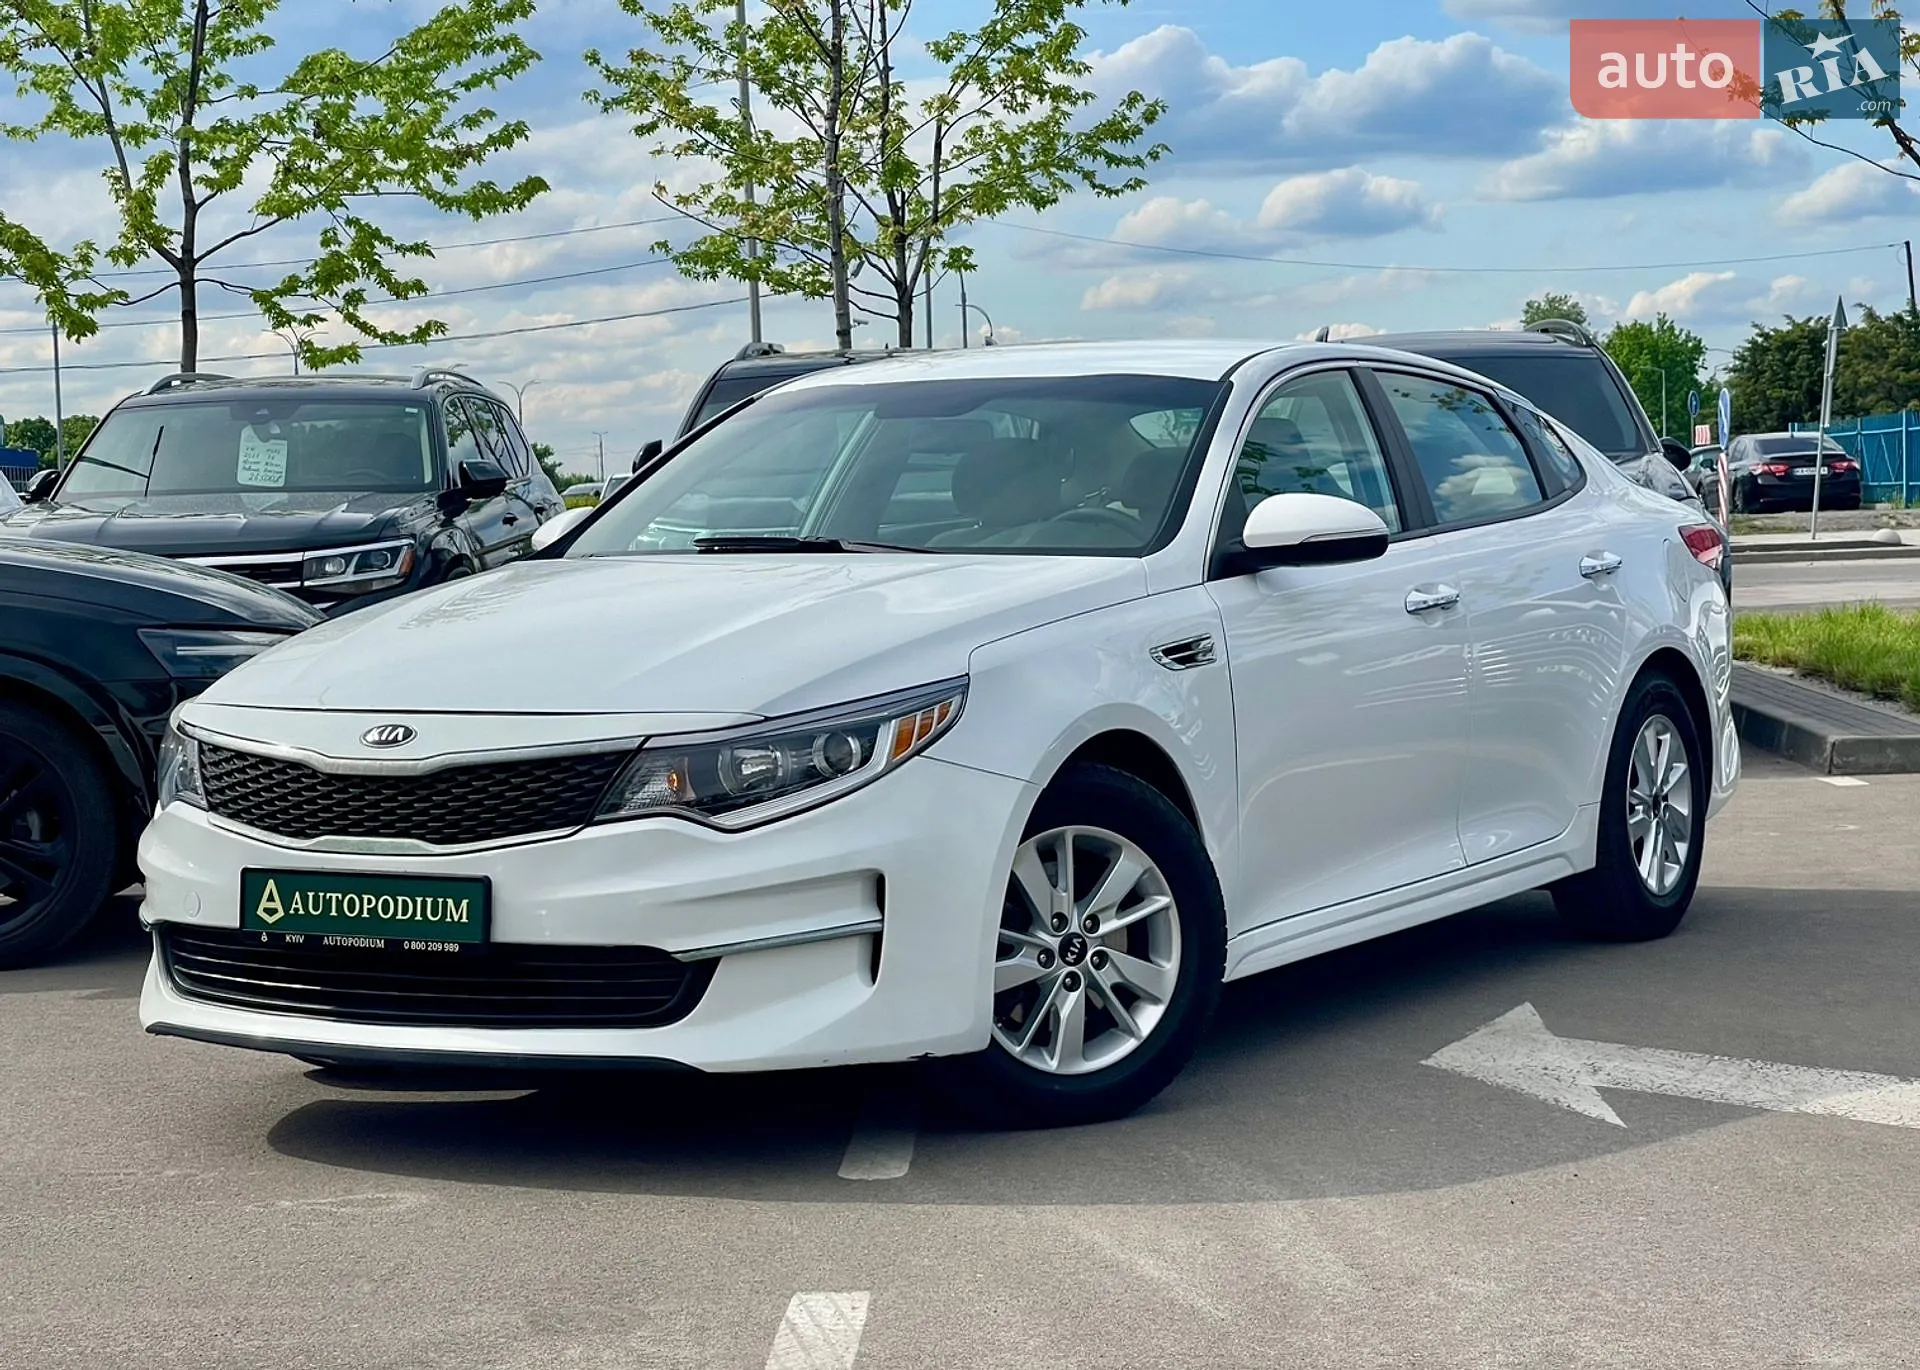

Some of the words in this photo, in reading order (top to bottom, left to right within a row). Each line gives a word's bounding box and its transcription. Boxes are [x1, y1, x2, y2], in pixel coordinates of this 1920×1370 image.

[365, 726, 405, 742] KIA
[288, 891, 470, 924] AUTOPODIUM
[285, 934, 305, 944] KYIV
[322, 936, 385, 949] AUTOPODIUM
[403, 940, 410, 950] 0
[410, 940, 426, 951] 800
[427, 941, 443, 952] 209
[443, 942, 459, 953] 989
[1065, 938, 1083, 963] KIA
